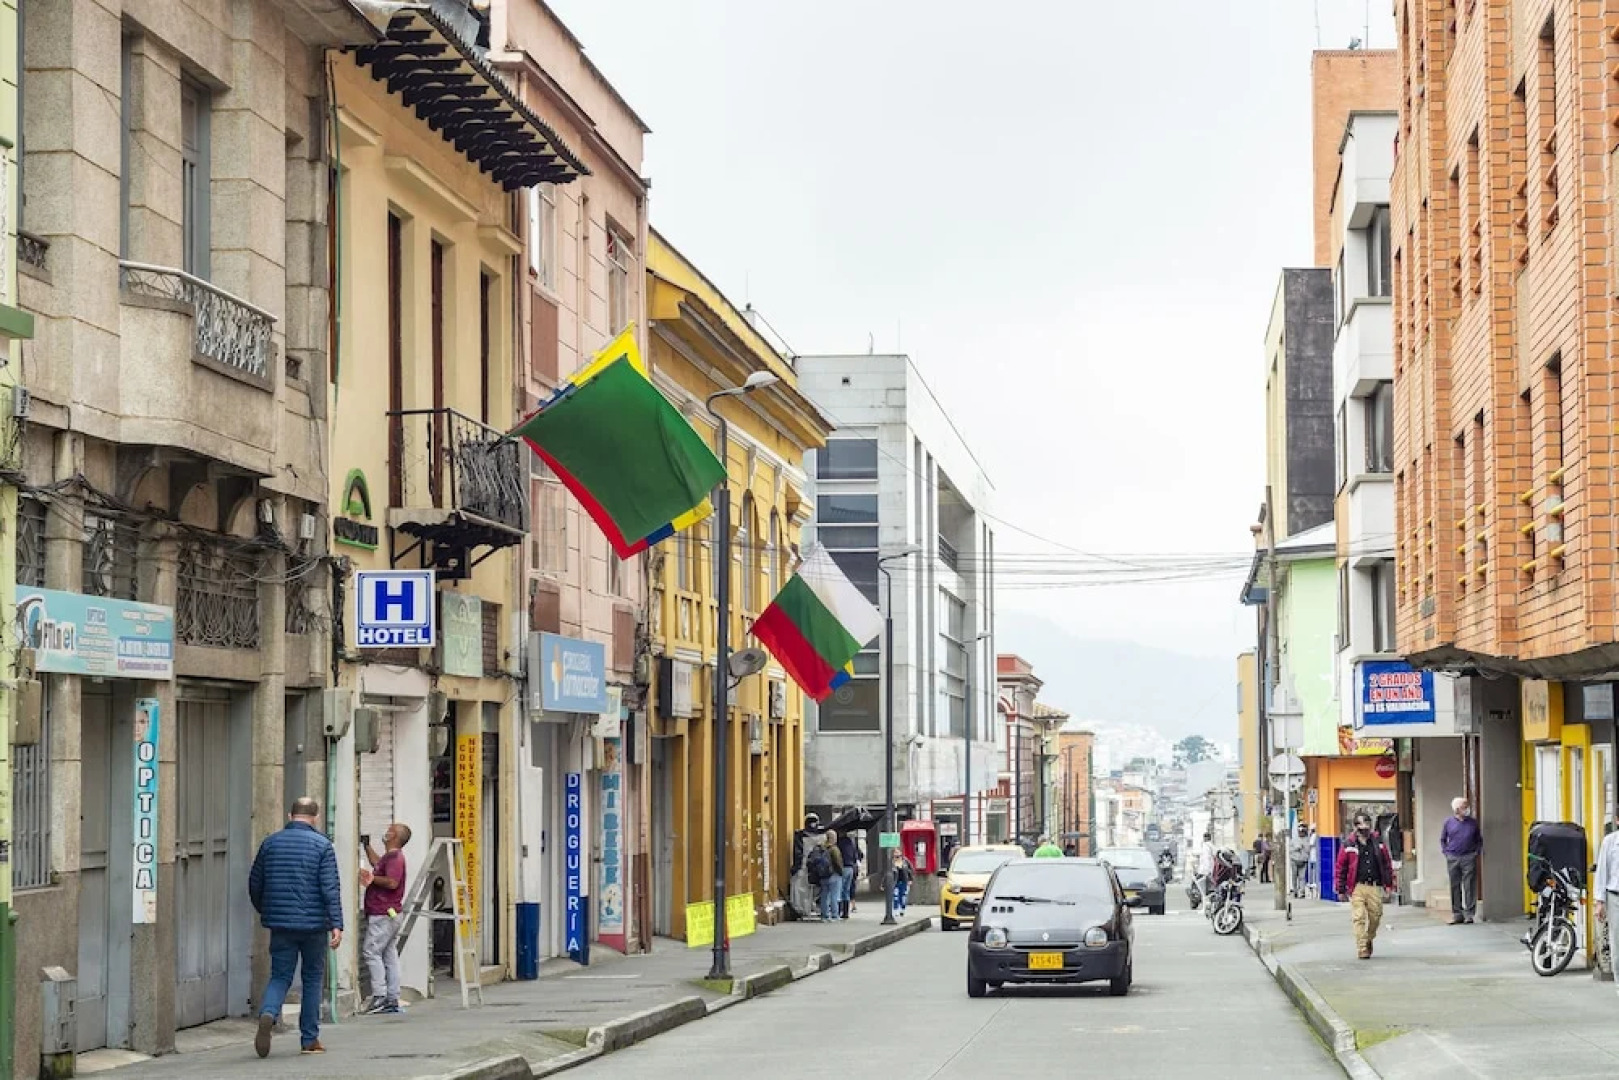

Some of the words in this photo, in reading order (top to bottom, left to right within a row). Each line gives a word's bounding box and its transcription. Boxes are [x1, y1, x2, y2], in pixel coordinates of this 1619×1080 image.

[376, 581, 413, 620] H
[360, 629, 429, 643] HOTEL
[1379, 672, 1422, 685] GRADOS
[137, 741, 155, 890] OPTICA
[567, 774, 579, 951] DROGUERÍA
